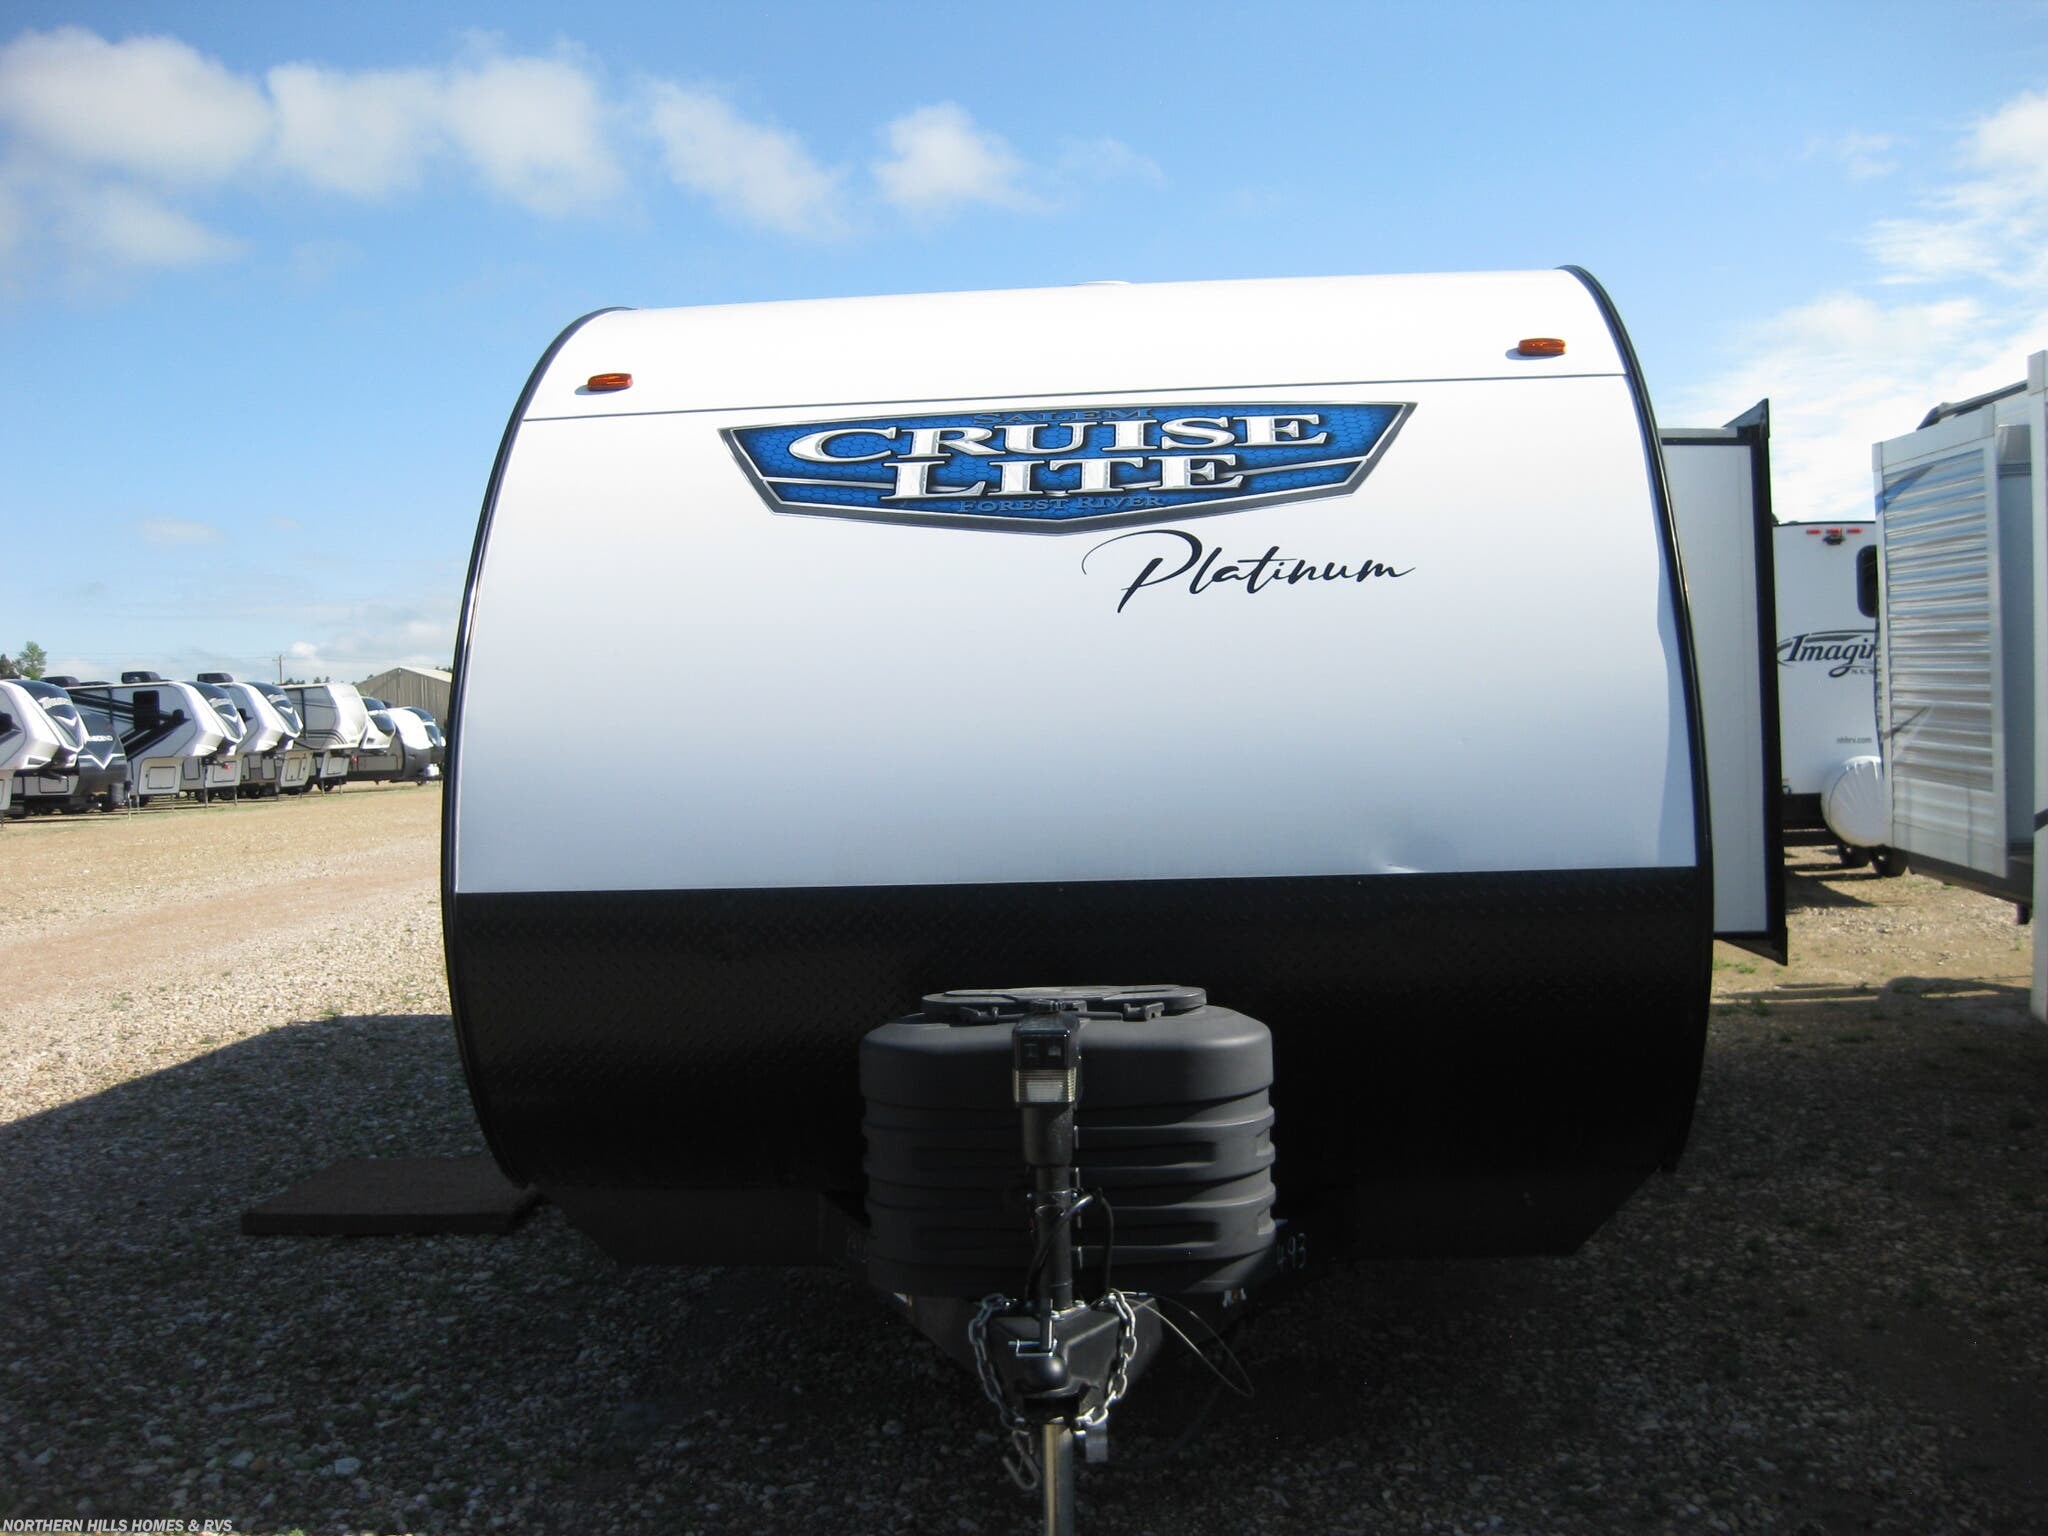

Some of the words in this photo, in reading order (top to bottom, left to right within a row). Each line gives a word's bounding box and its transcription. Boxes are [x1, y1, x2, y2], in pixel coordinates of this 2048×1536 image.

[789, 414, 1328, 463] CRUISE
[973, 409, 1152, 424] SALEM
[880, 455, 1244, 500] LITE
[958, 499, 1070, 513] FOREST
[1077, 496, 1164, 510] RIVER
[1081, 530, 1415, 613] Platinum
